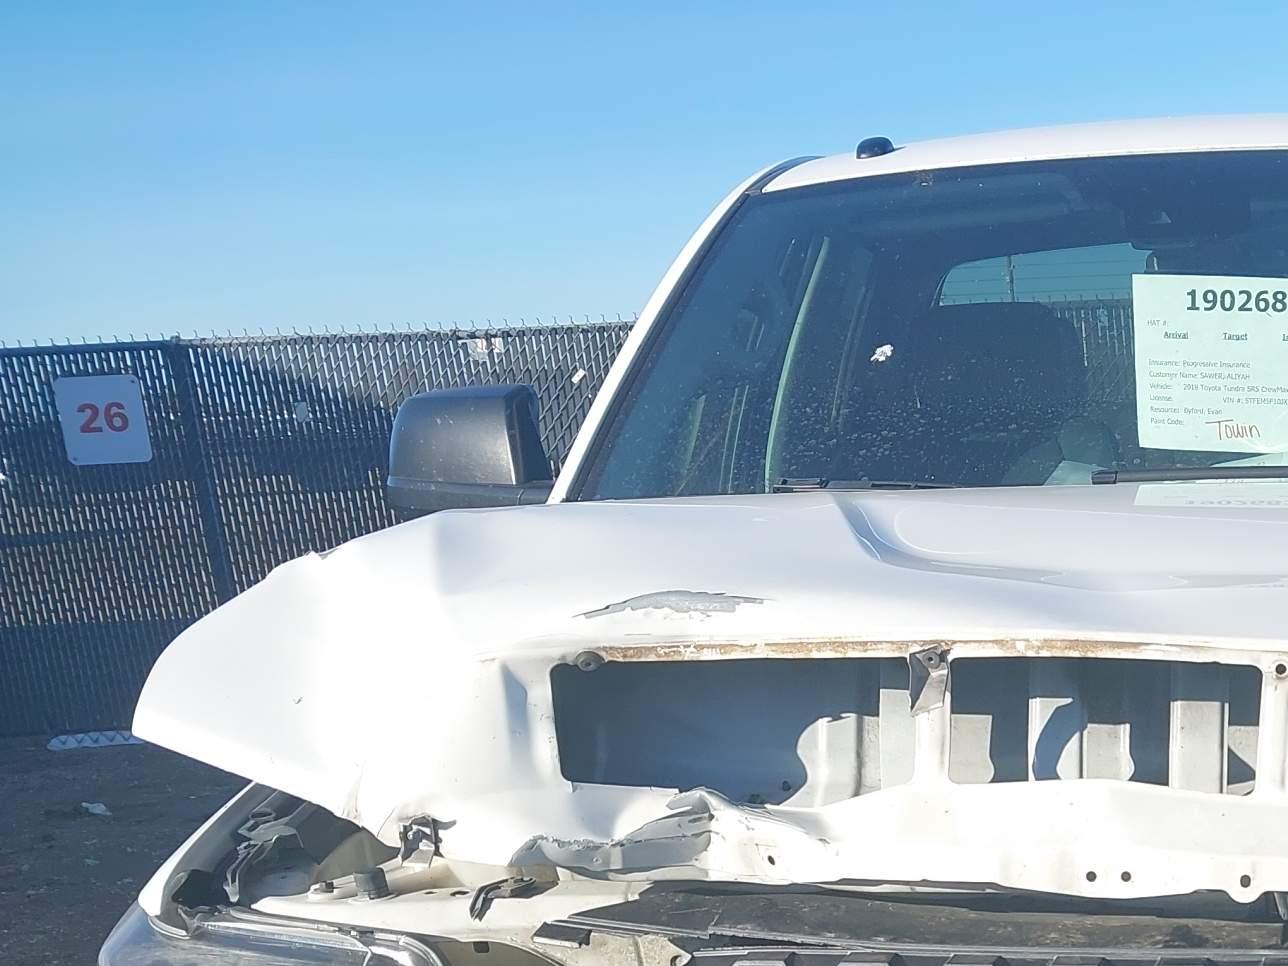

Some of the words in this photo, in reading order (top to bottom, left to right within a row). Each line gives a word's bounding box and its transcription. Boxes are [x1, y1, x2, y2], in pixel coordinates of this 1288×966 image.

[1163, 331, 1189, 340] Arrival
[1223, 332, 1248, 341] Target
[1219, 360, 1251, 368] Insurance
[1200, 384, 1221, 392] Toyota
[76, 401, 129, 433] 26
